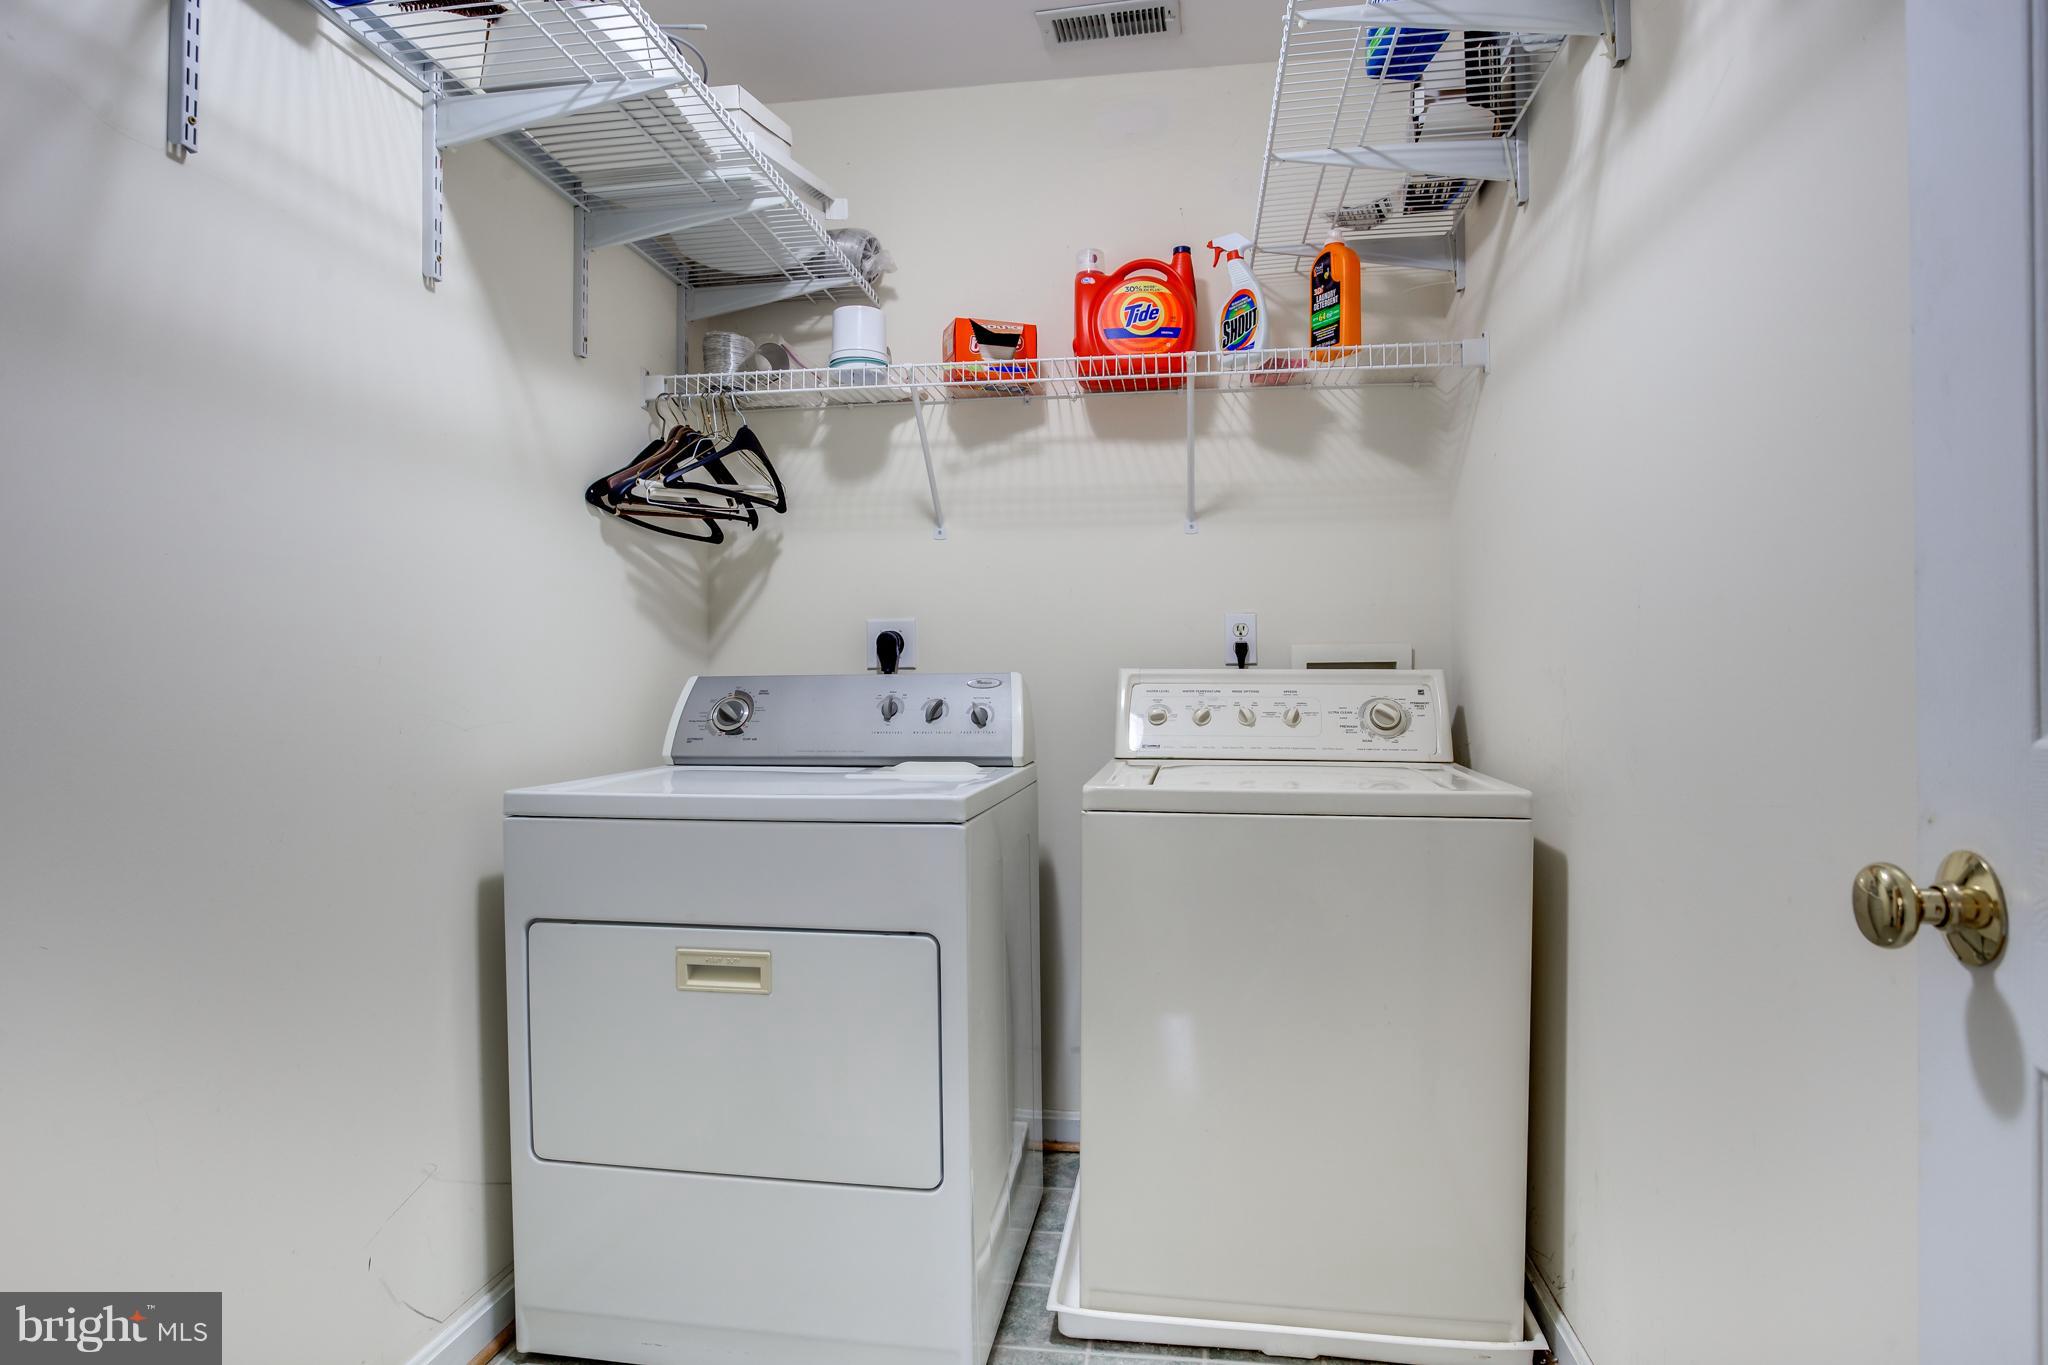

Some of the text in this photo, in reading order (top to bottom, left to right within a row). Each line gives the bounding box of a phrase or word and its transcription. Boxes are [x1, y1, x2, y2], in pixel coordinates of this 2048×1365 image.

[1124, 303, 1160, 328] Tide
[1313, 295, 1339, 311] DETERGENT
[1222, 307, 1258, 349] SHOUT
